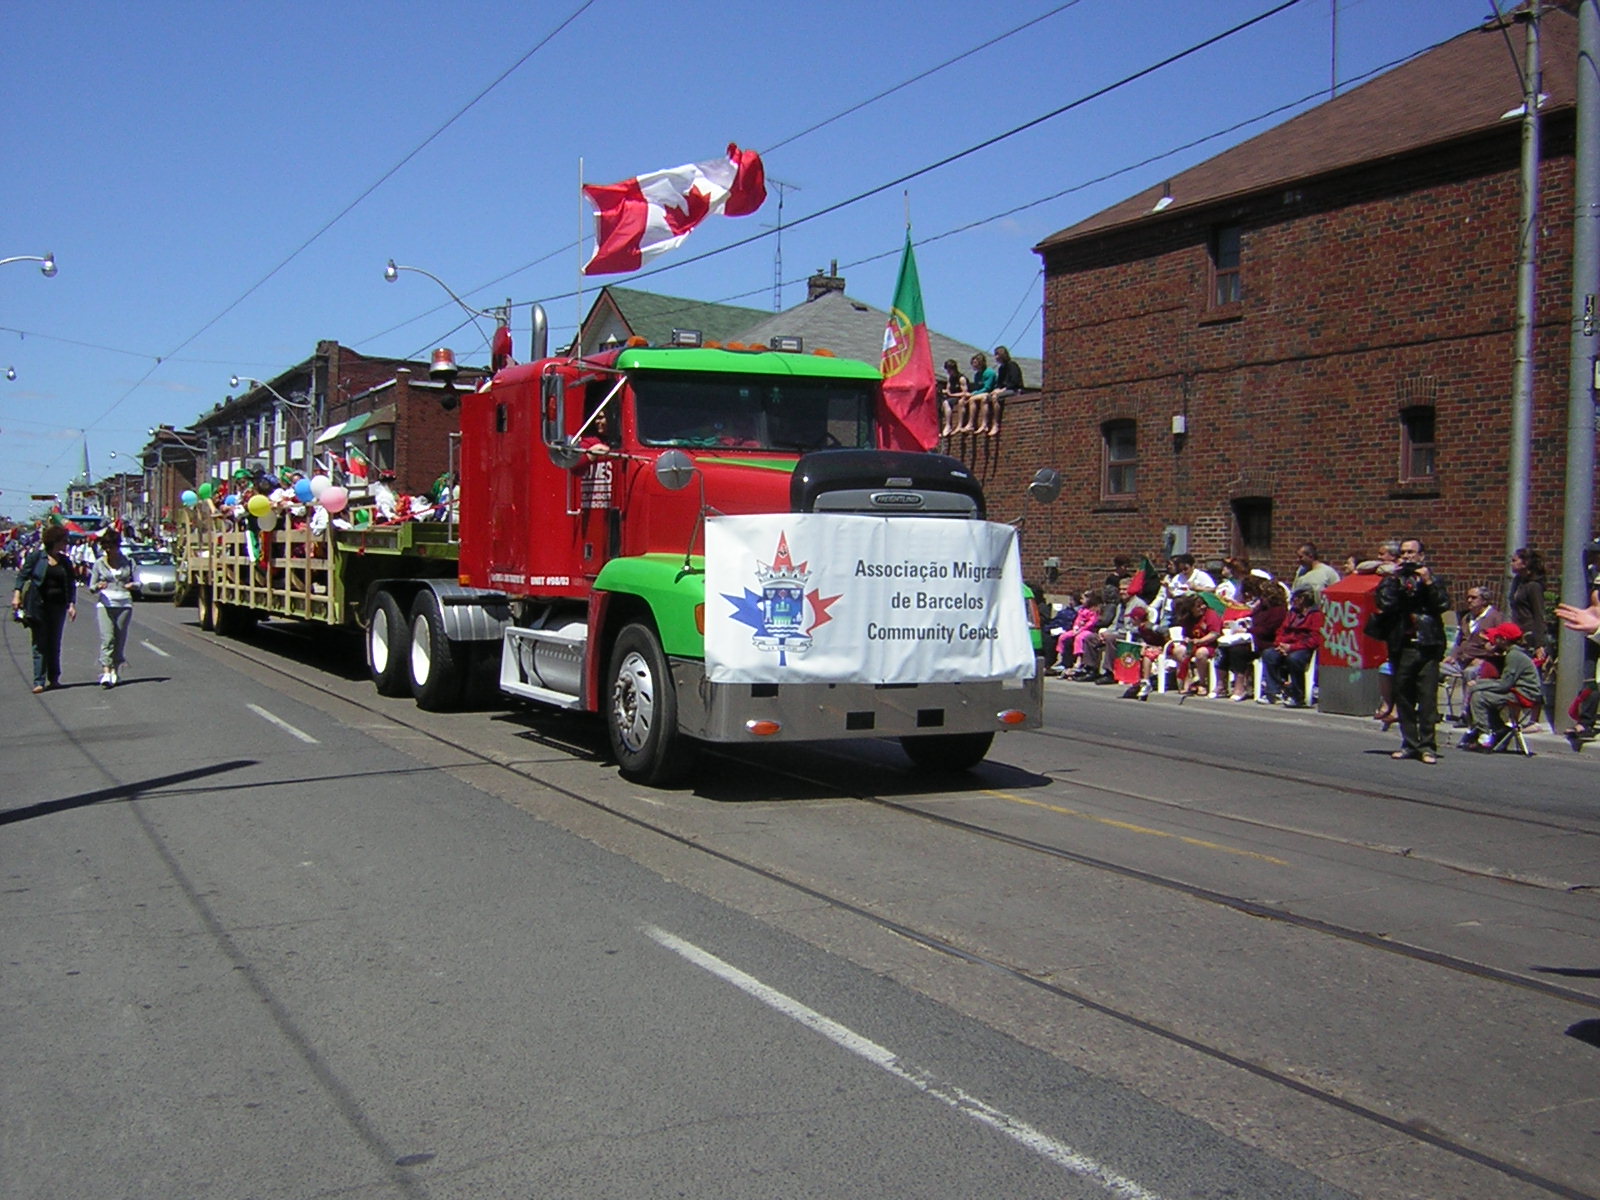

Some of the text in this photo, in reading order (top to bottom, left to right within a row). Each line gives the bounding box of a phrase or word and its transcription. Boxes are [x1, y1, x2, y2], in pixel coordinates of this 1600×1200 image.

[854, 559, 948, 583] Associação
[891, 591, 984, 610] de Barcelos
[867, 622, 999, 644] Community Cente
